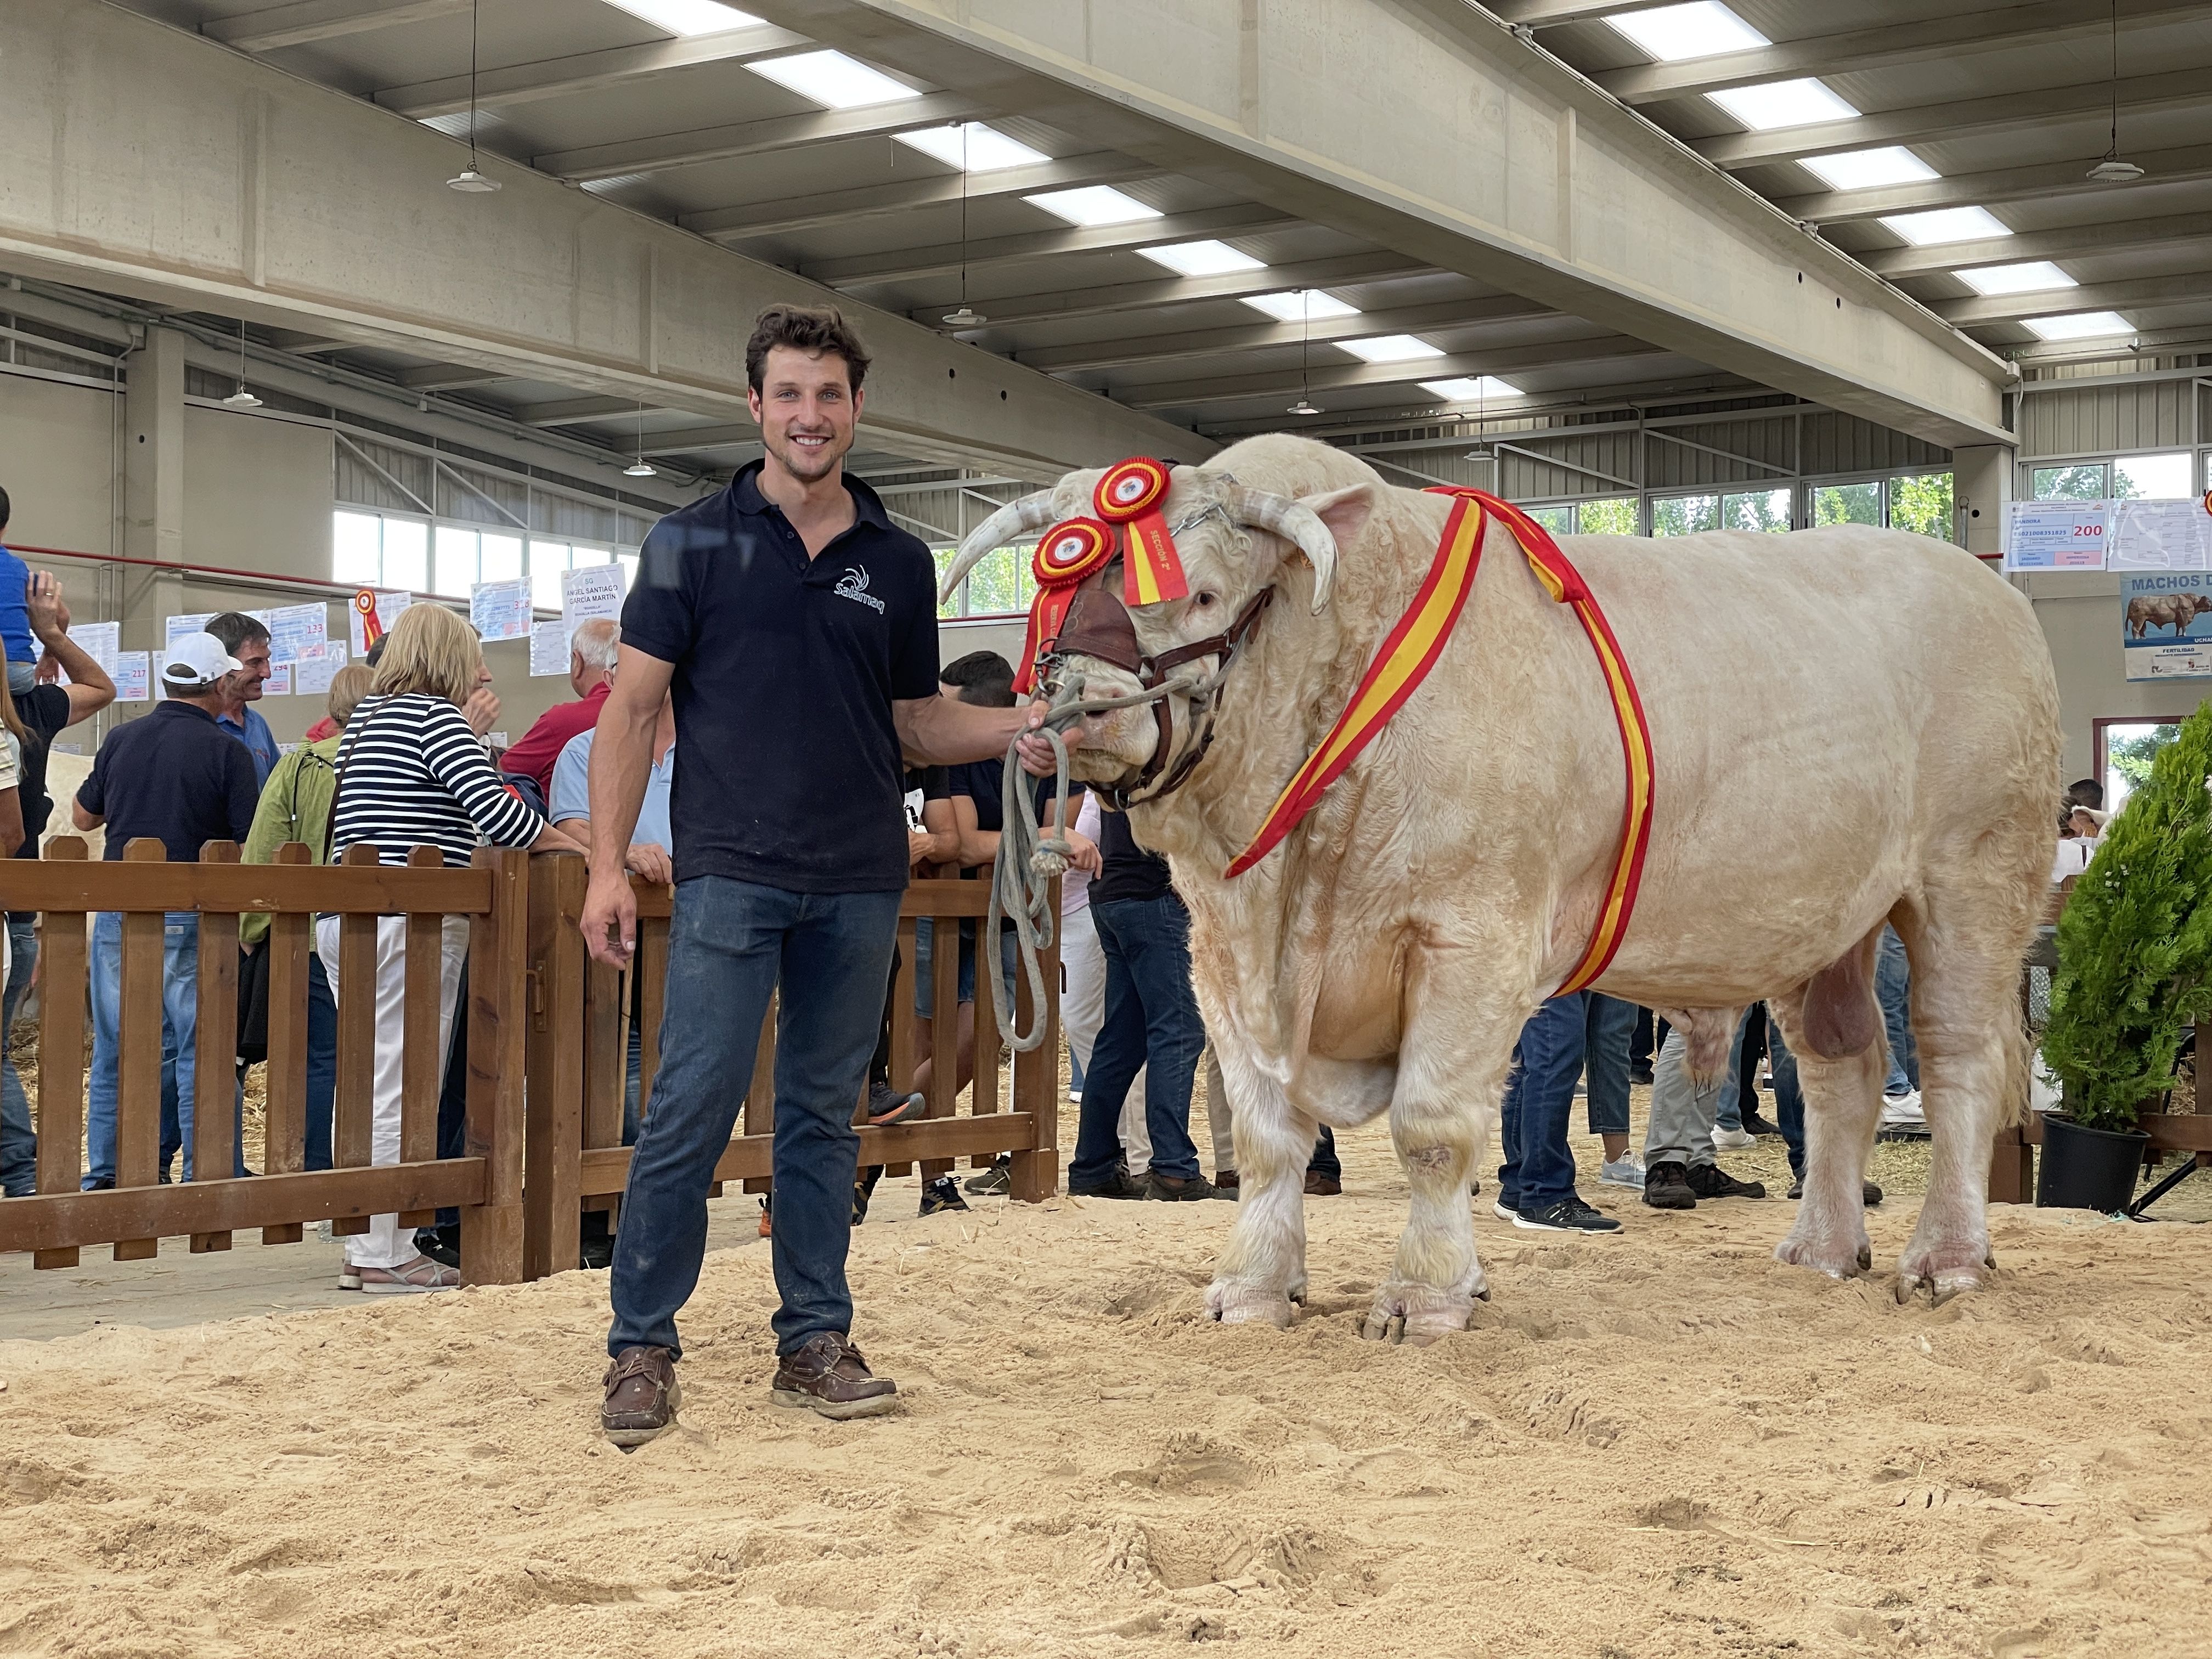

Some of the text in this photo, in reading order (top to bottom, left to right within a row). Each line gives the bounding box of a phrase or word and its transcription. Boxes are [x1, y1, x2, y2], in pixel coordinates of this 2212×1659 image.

[2074, 525, 2102, 537] 200
[1150, 530, 1167, 561] SECCIÓN
[585, 584, 618, 594] SANTIAGO
[2132, 575, 2200, 590] MACHOS
[569, 593, 616, 604] GARCÍA MARTÍN
[834, 582, 885, 615] Salamaq
